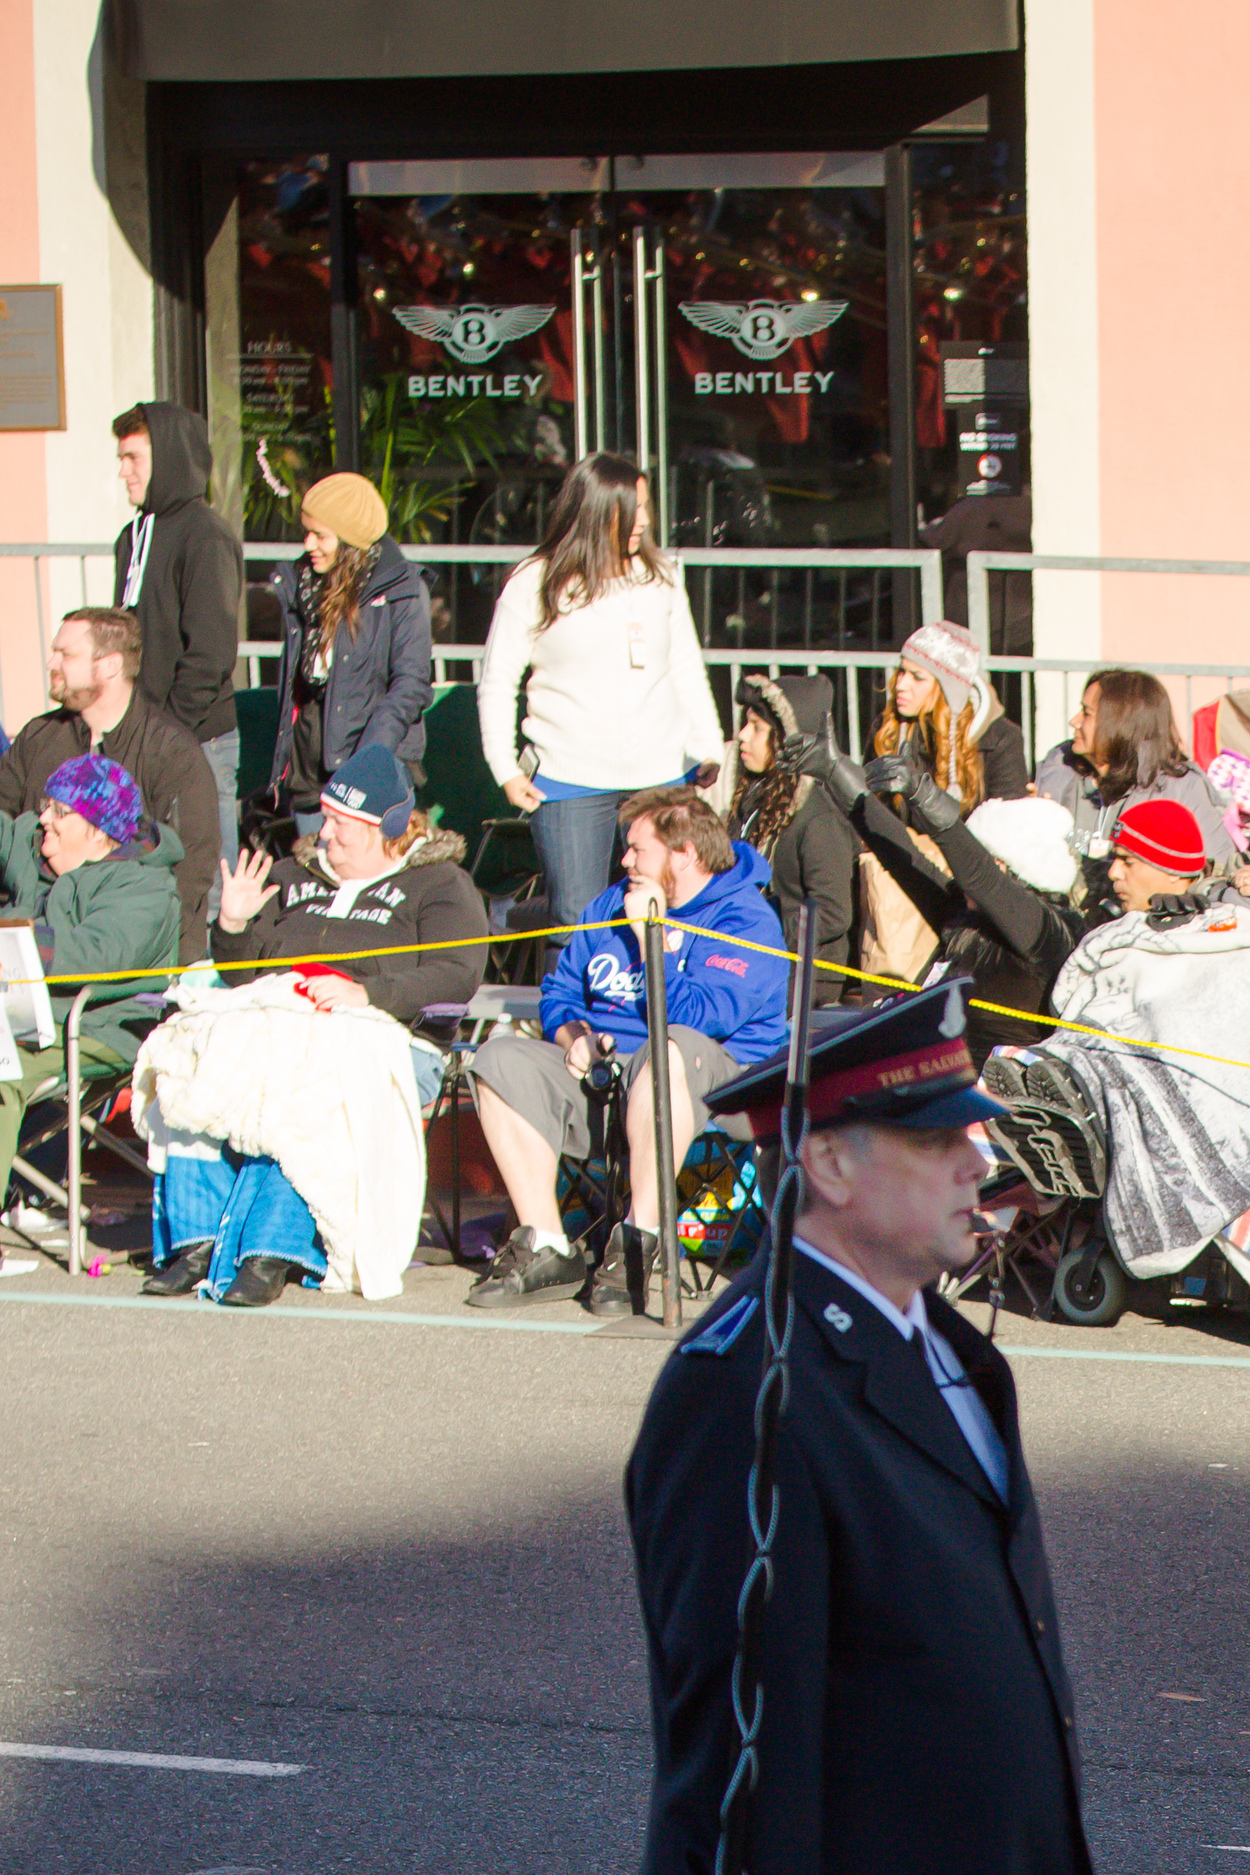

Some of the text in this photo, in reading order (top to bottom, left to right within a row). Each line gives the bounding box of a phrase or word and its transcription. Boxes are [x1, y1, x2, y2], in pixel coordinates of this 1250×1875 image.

[407, 373, 544, 398] BENTLEY
[693, 370, 835, 395] BENTLEY
[878, 1065, 915, 1088] THE
[823, 1302, 853, 1333] S
